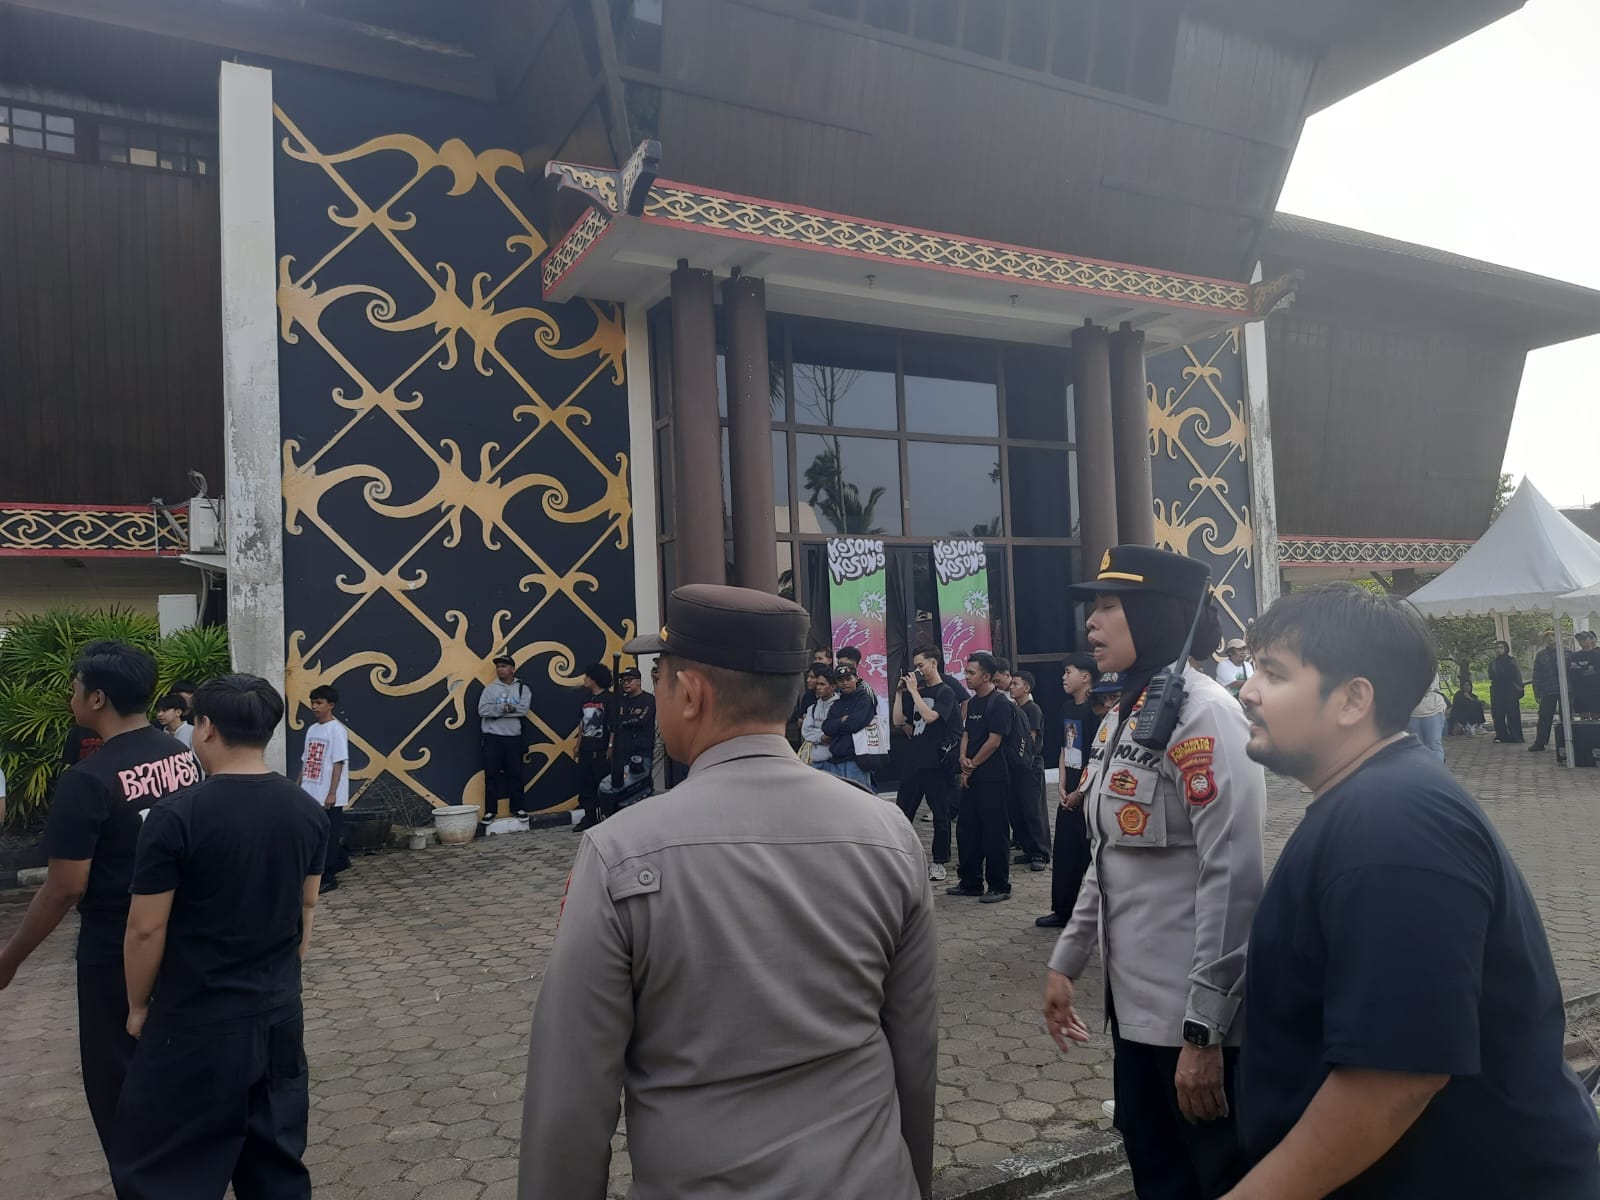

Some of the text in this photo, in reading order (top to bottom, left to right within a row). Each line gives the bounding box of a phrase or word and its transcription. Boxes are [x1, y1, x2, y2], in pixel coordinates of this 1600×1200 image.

[827, 538, 883, 561] KOSONG
[933, 540, 984, 562] KOSONG
[828, 553, 885, 583] KOSONG
[935, 553, 986, 584] KOSONG
[1113, 743, 1161, 768] POLRI
